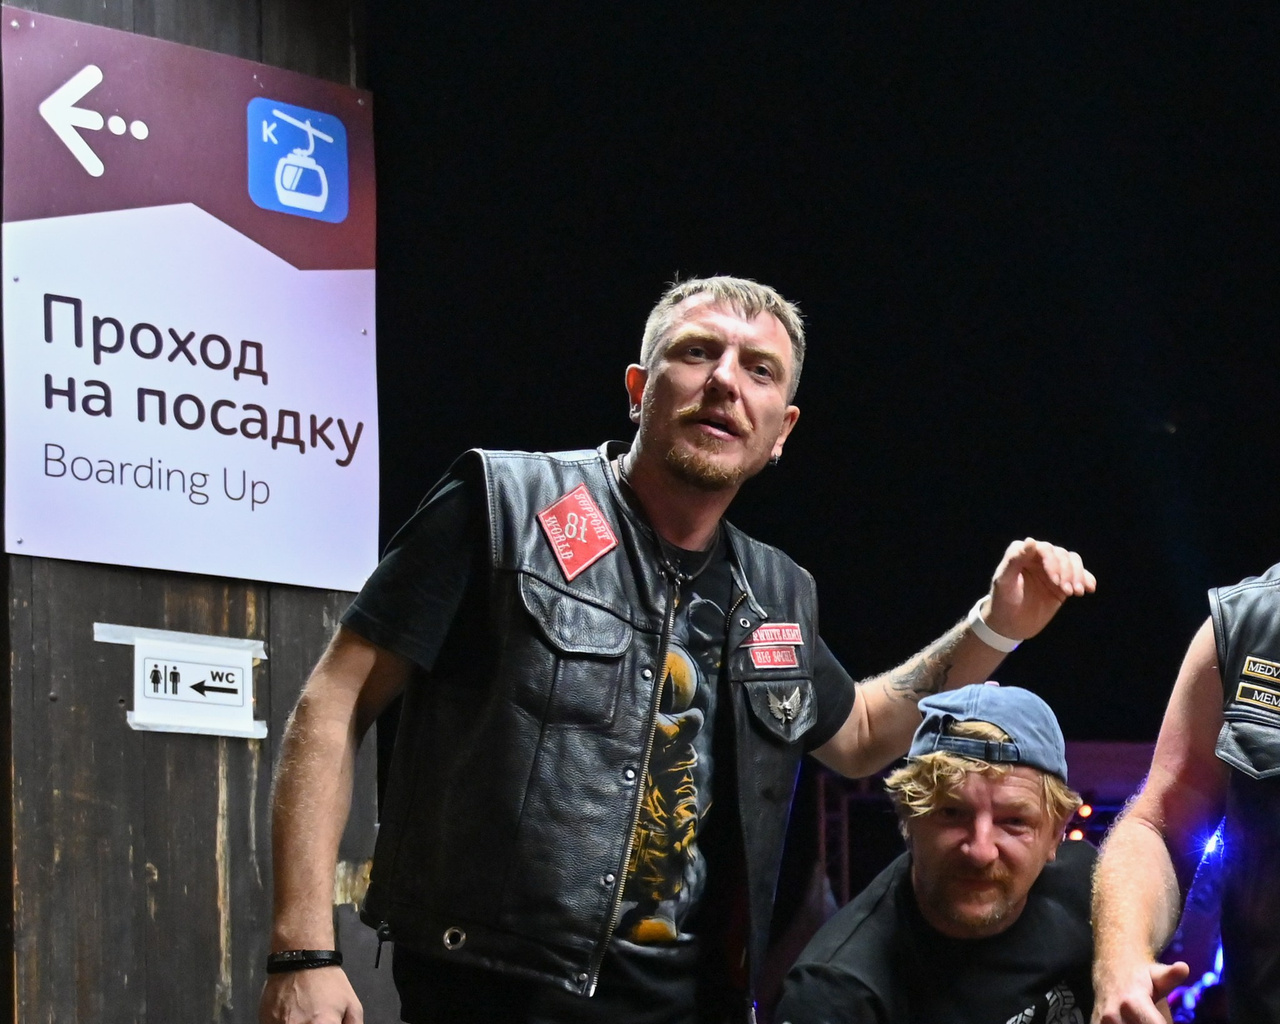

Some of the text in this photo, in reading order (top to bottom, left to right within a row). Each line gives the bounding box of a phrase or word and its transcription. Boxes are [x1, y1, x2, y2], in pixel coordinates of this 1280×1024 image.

[42, 292, 269, 386] Проход
[43, 373, 365, 468] на посадку
[43, 442, 271, 512] Boarding Up
[545, 514, 574, 559] WORLD
[564, 512, 588, 543] 81
[574, 493, 611, 540] SUPPORT
[210, 670, 235, 684] WC
